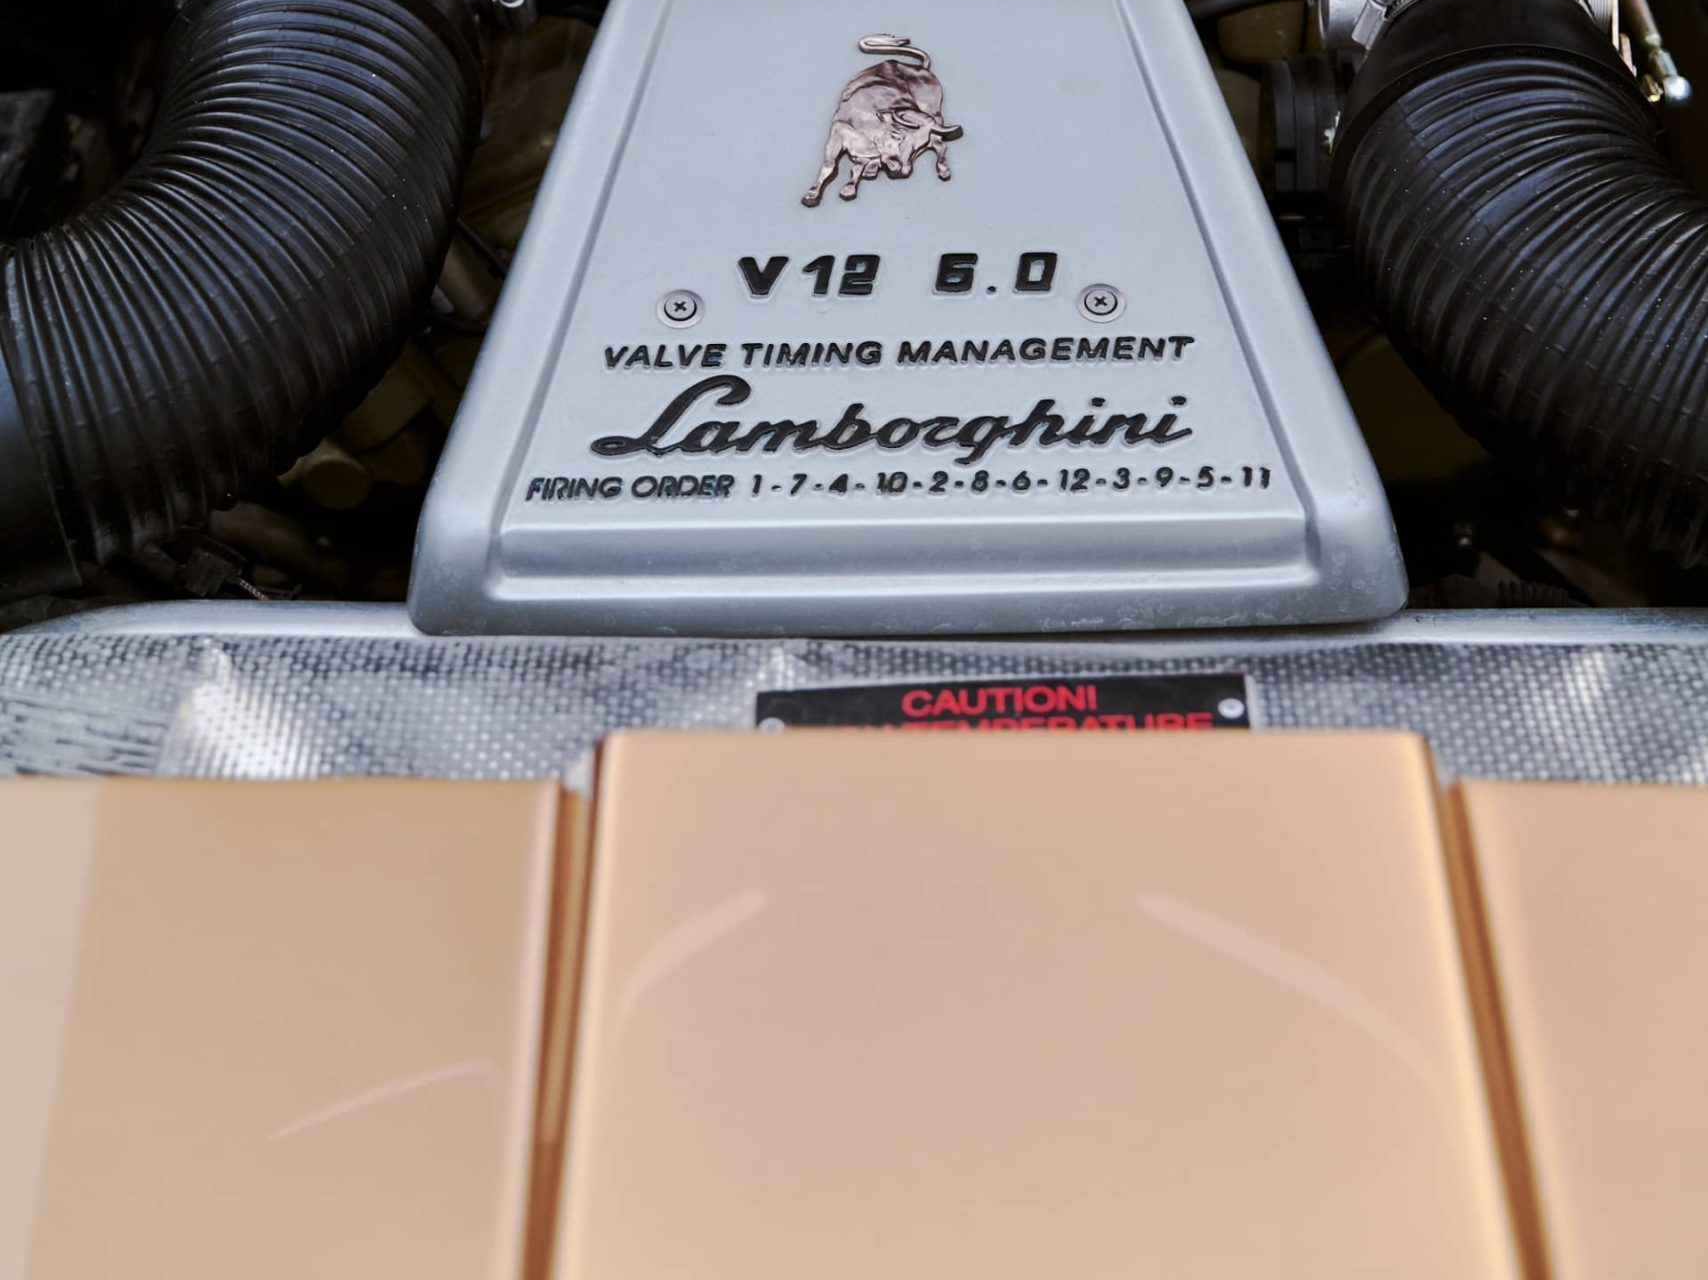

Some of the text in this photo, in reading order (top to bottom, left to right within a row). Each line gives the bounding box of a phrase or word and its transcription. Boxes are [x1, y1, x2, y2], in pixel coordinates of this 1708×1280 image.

[737, 252, 1058, 297] V12 6.0
[603, 335, 1196, 368] VALVE TIMING MANAGEMENT
[590, 374, 1193, 466] Lamborghini
[524, 476, 624, 502] FIRING
[630, 474, 736, 499] ORDER
[901, 684, 1097, 718] CAUTION!
